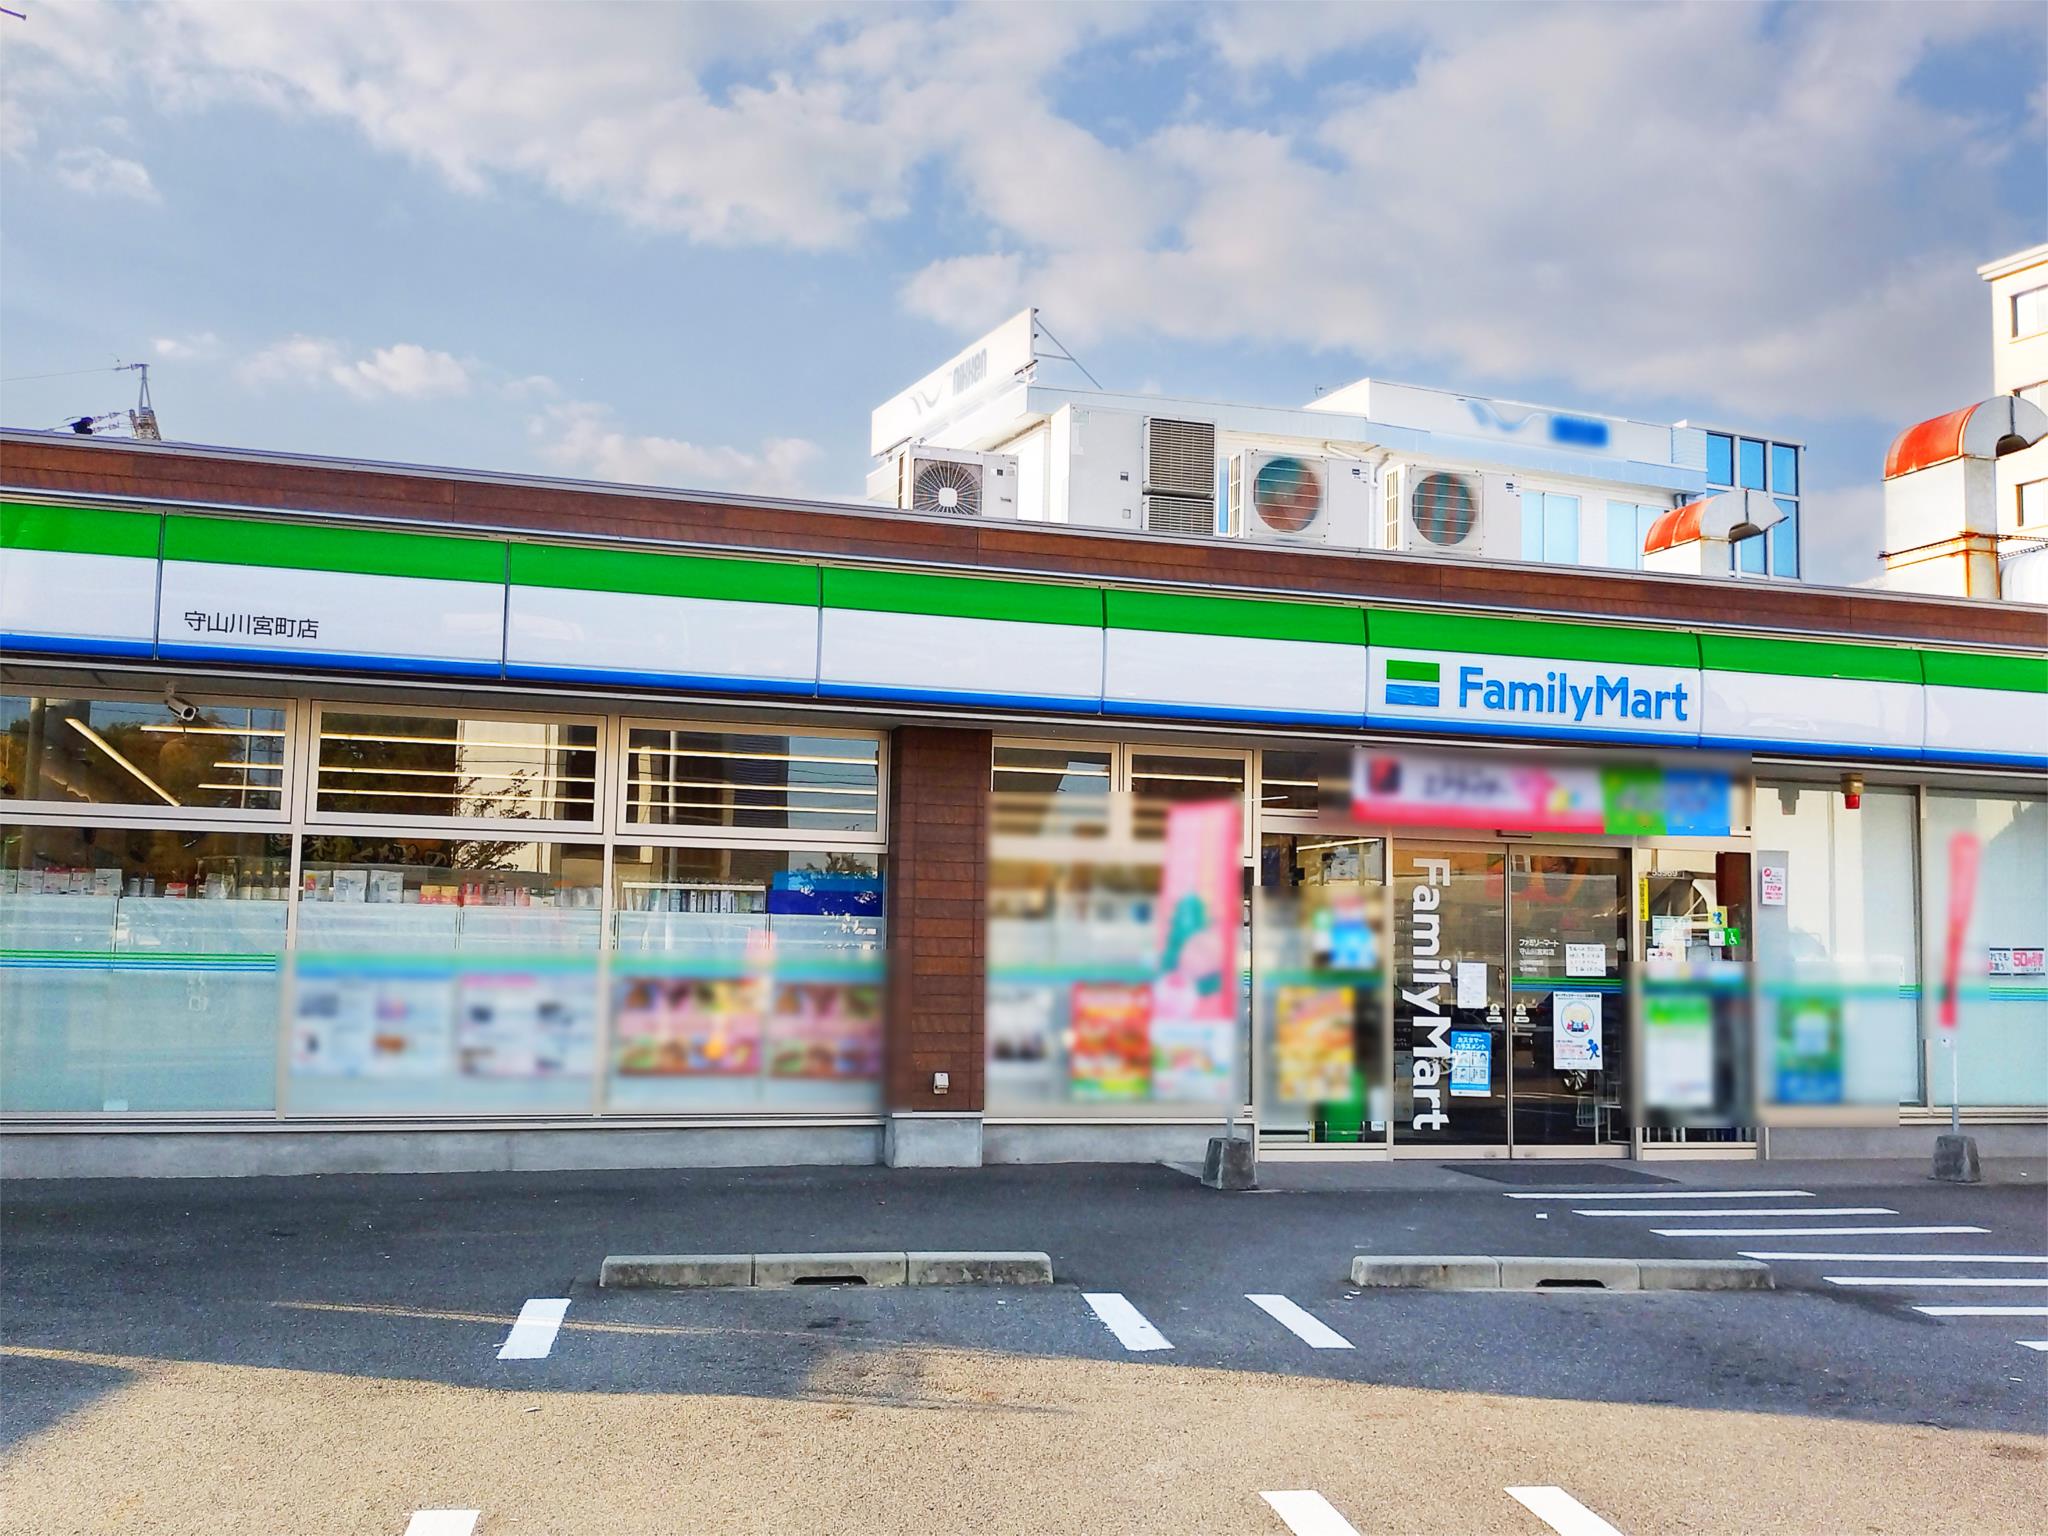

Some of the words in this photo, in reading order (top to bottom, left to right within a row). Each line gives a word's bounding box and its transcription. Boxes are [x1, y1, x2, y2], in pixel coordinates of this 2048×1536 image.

[184, 611, 319, 639] 守山川宮町店
[1459, 665, 1688, 722] FamilyMart
[1402, 858, 1451, 1131] FamilyMart
